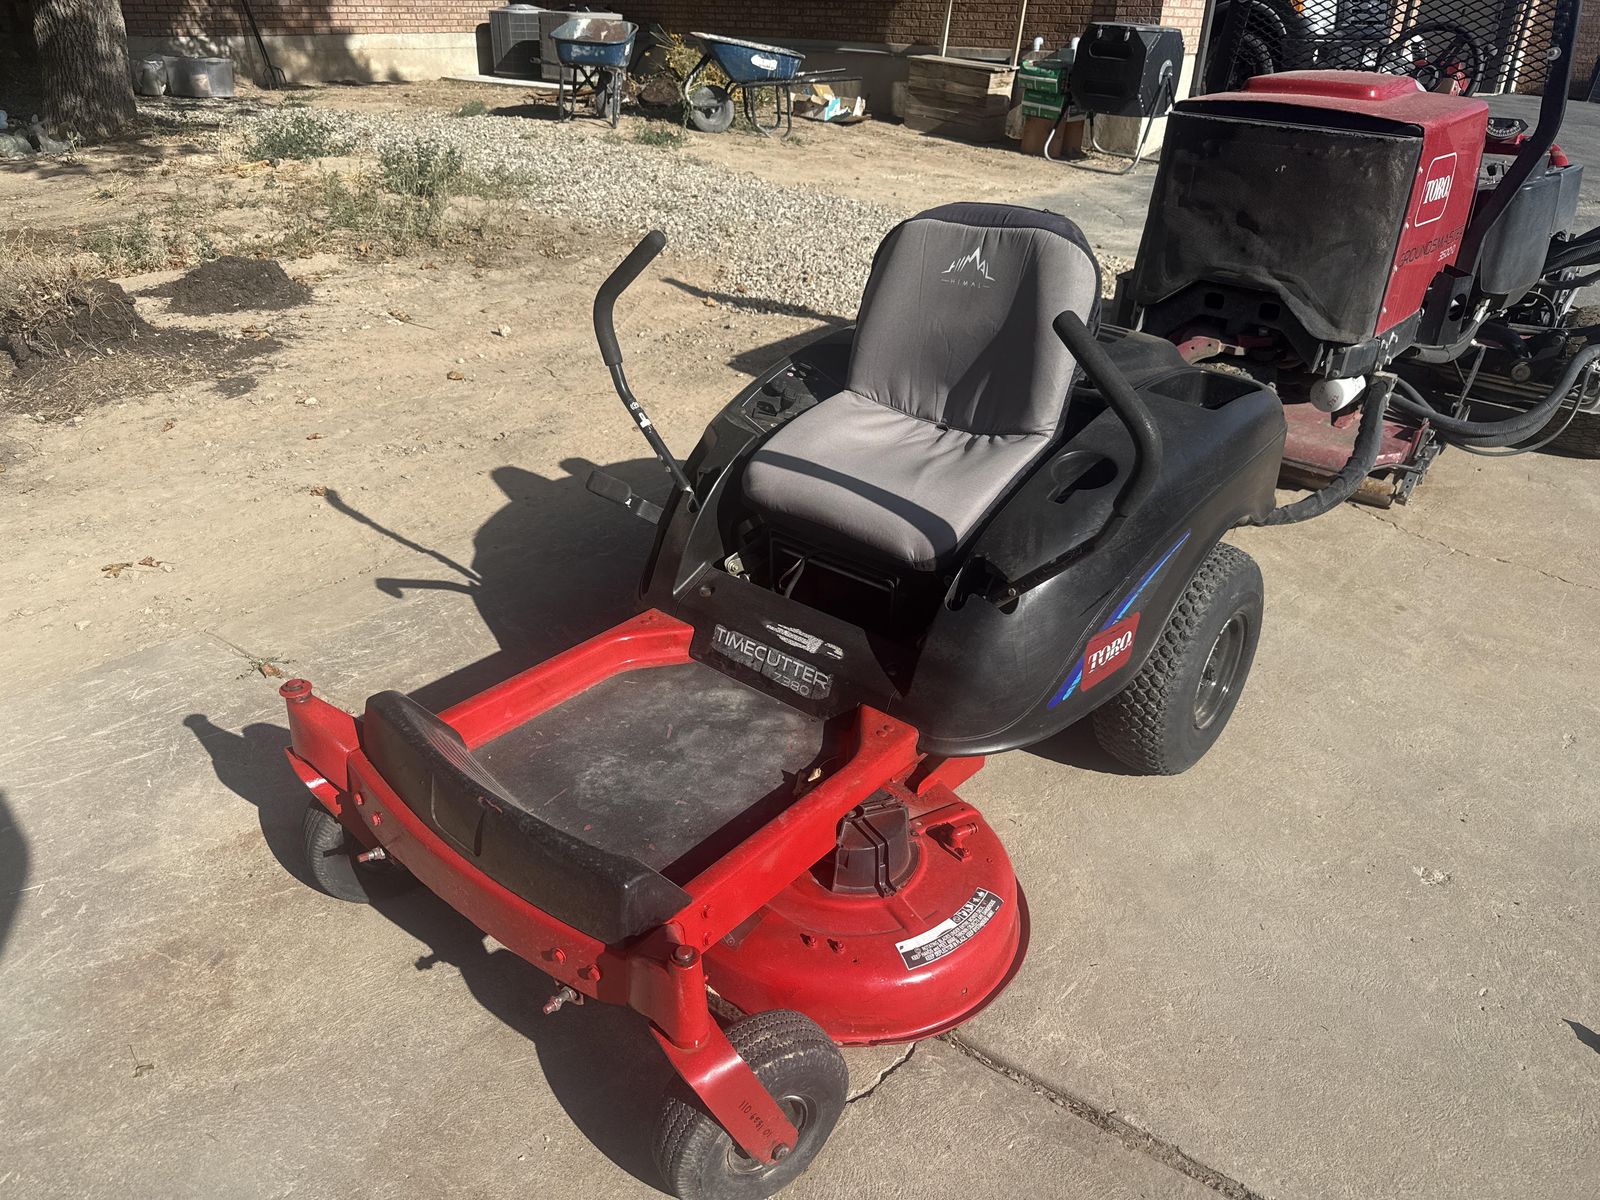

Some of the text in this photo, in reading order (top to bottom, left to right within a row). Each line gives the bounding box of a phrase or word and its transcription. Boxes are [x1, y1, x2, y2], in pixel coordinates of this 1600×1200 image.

[1423, 175, 1450, 204] TORO
[716, 626, 829, 690] TIMECUTTER
[1087, 630, 1132, 674] TORO
[773, 671, 810, 696] Z380
